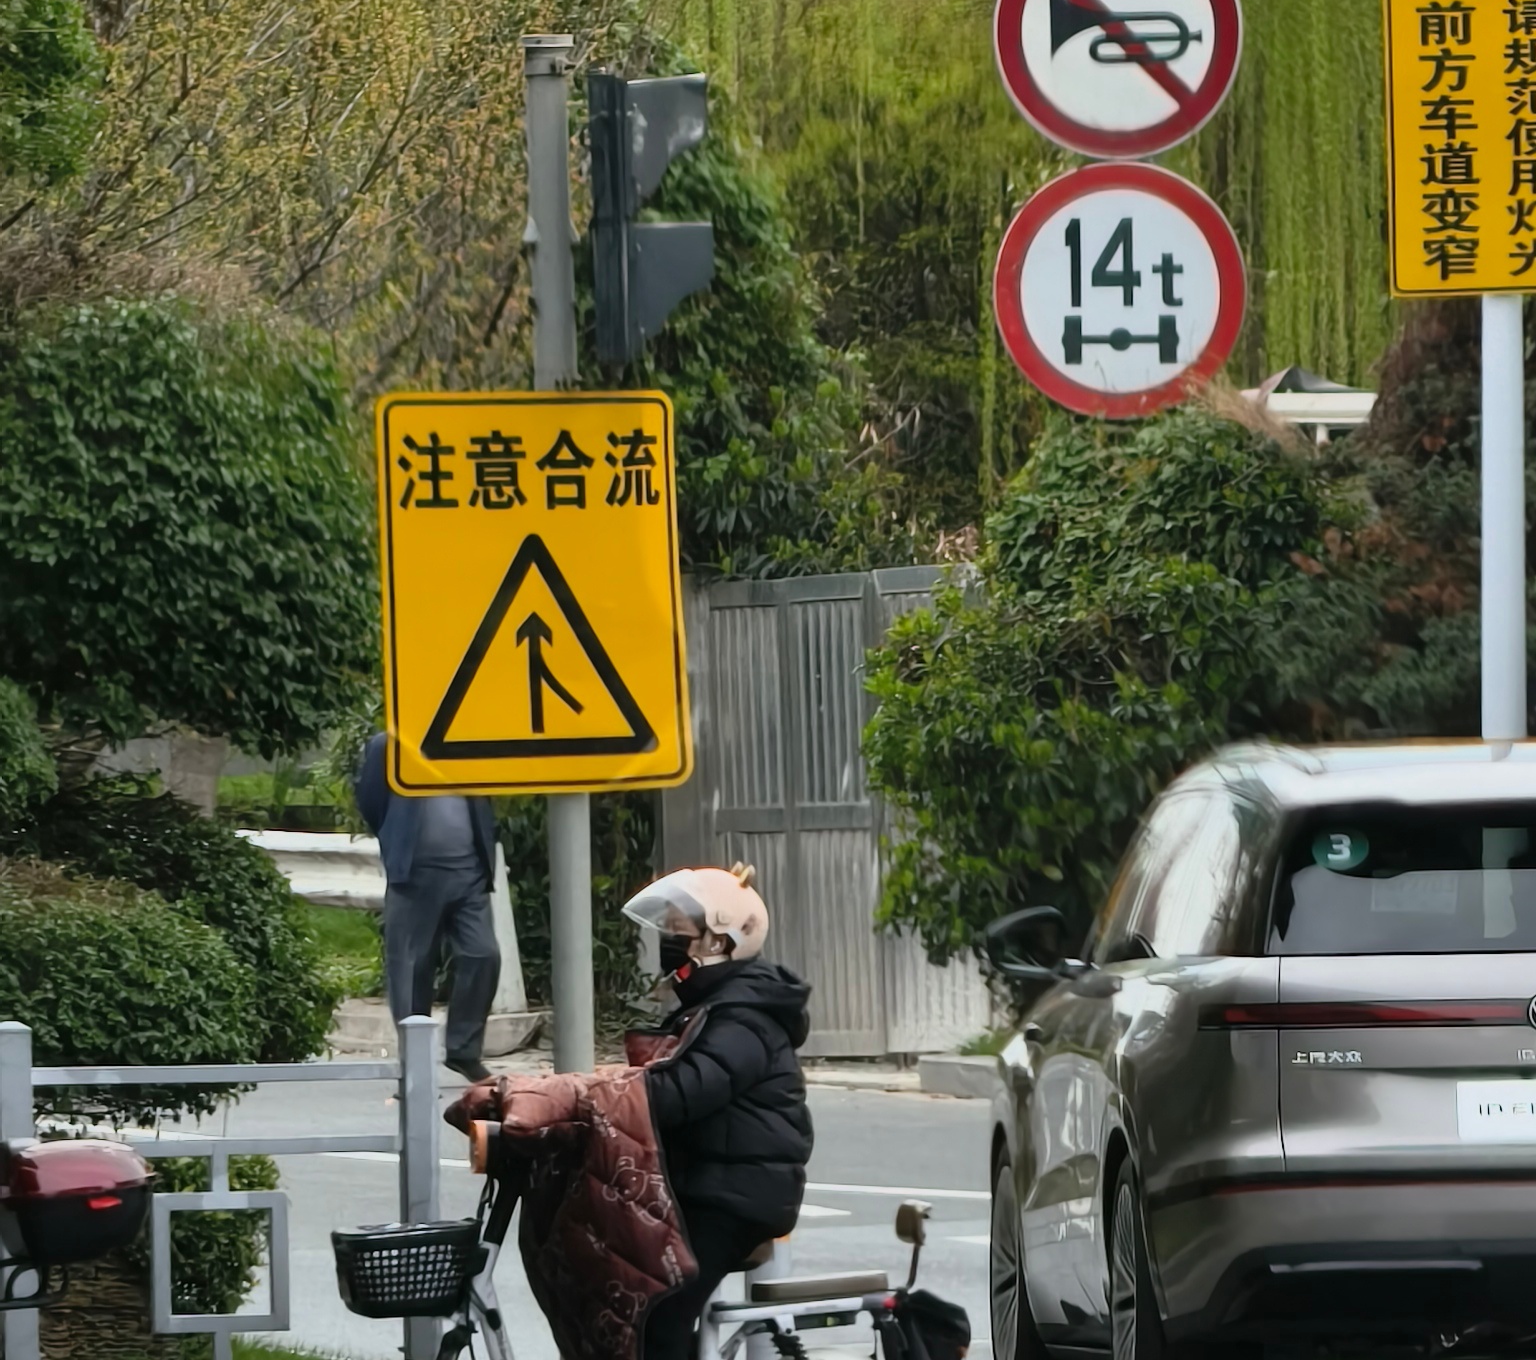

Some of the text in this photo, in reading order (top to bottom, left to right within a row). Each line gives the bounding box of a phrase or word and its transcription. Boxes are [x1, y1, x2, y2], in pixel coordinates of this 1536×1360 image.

[1416, 0, 1480, 281] 前方车道变窄
[1064, 217, 1184, 308] 14t
[398, 428, 660, 511] 注意合流
[1327, 833, 1351, 861] 3
